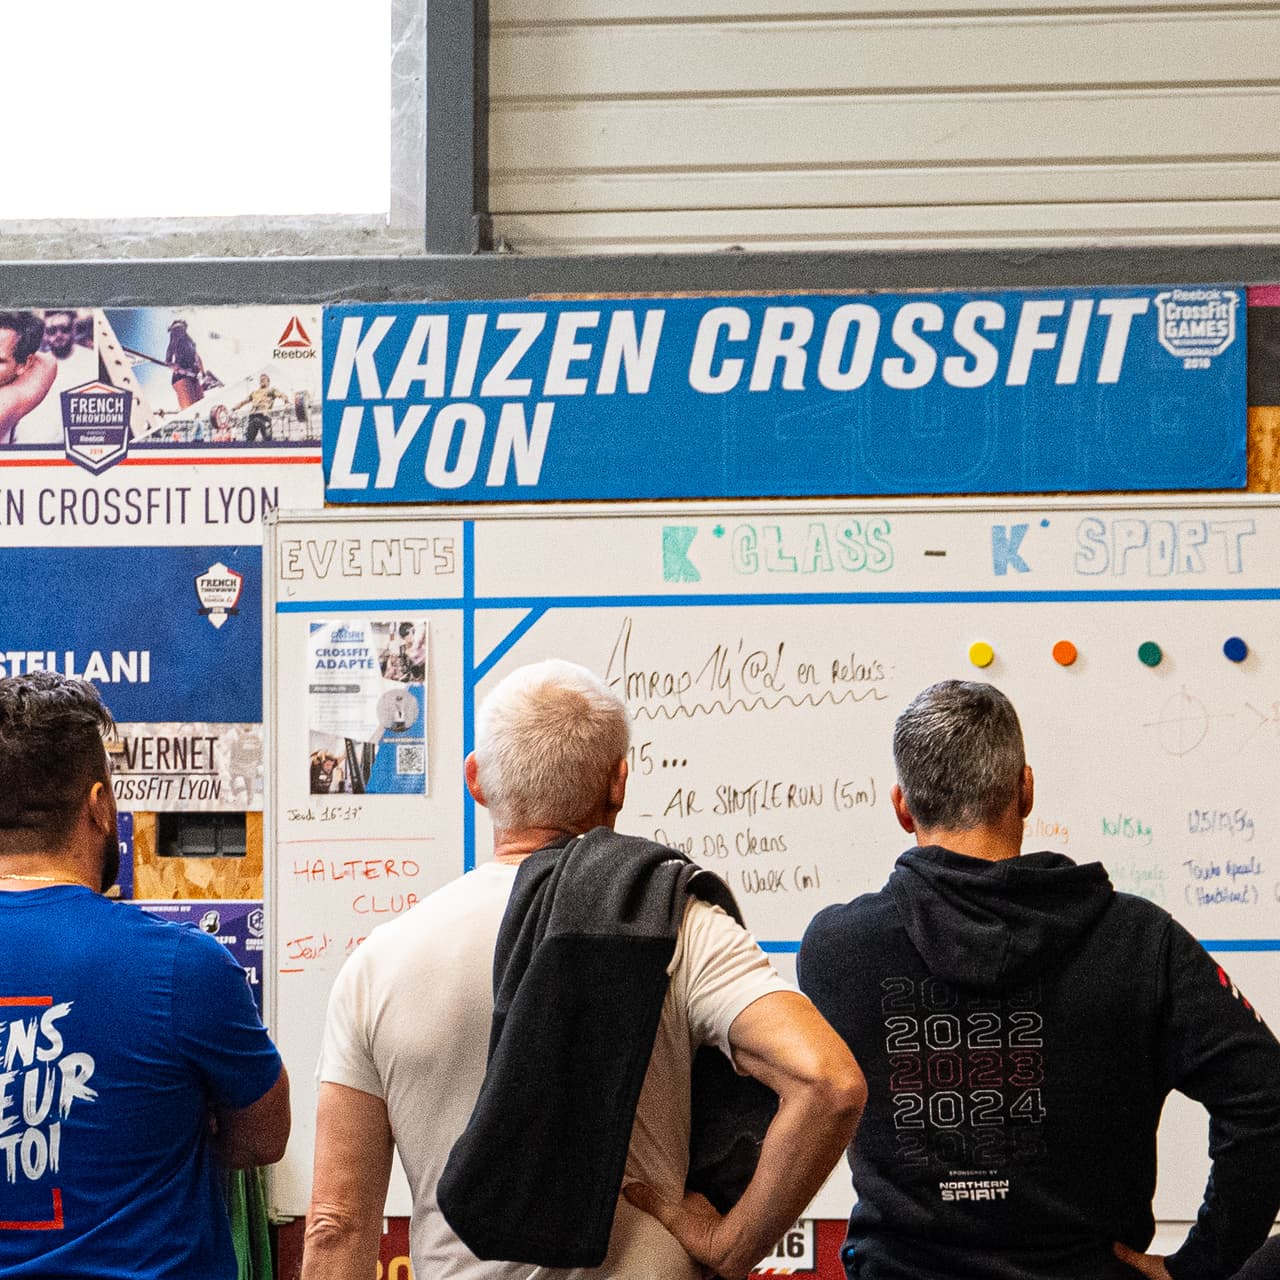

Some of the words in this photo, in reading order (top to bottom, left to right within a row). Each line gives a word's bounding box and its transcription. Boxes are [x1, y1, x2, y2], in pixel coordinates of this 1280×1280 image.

[1165, 320, 1228, 338] GAMES
[273, 348, 317, 360] Reebok
[326, 308, 668, 402] KAIZEN
[686, 296, 1150, 396] CROSSFIT
[70, 397, 124, 413] FRENCH
[70, 413, 124, 424] THROWDOWN
[327, 402, 556, 491] LYON
[38, 487, 192, 527] CROSSFIT
[204, 485, 280, 526] LYON
[280, 537, 455, 580] EVENTS
[1074, 517, 1257, 577] SPORT
[315, 647, 369, 658] CROSSFIT
[292, 858, 421, 883] HALTERO
[884, 1010, 1045, 1054] 2022
[889, 1049, 1047, 1092] 2023
[892, 1088, 1047, 1130] 2024
[939, 1179, 1010, 1191] NORTHERN
[941, 1188, 1010, 1201] SPIRIT
